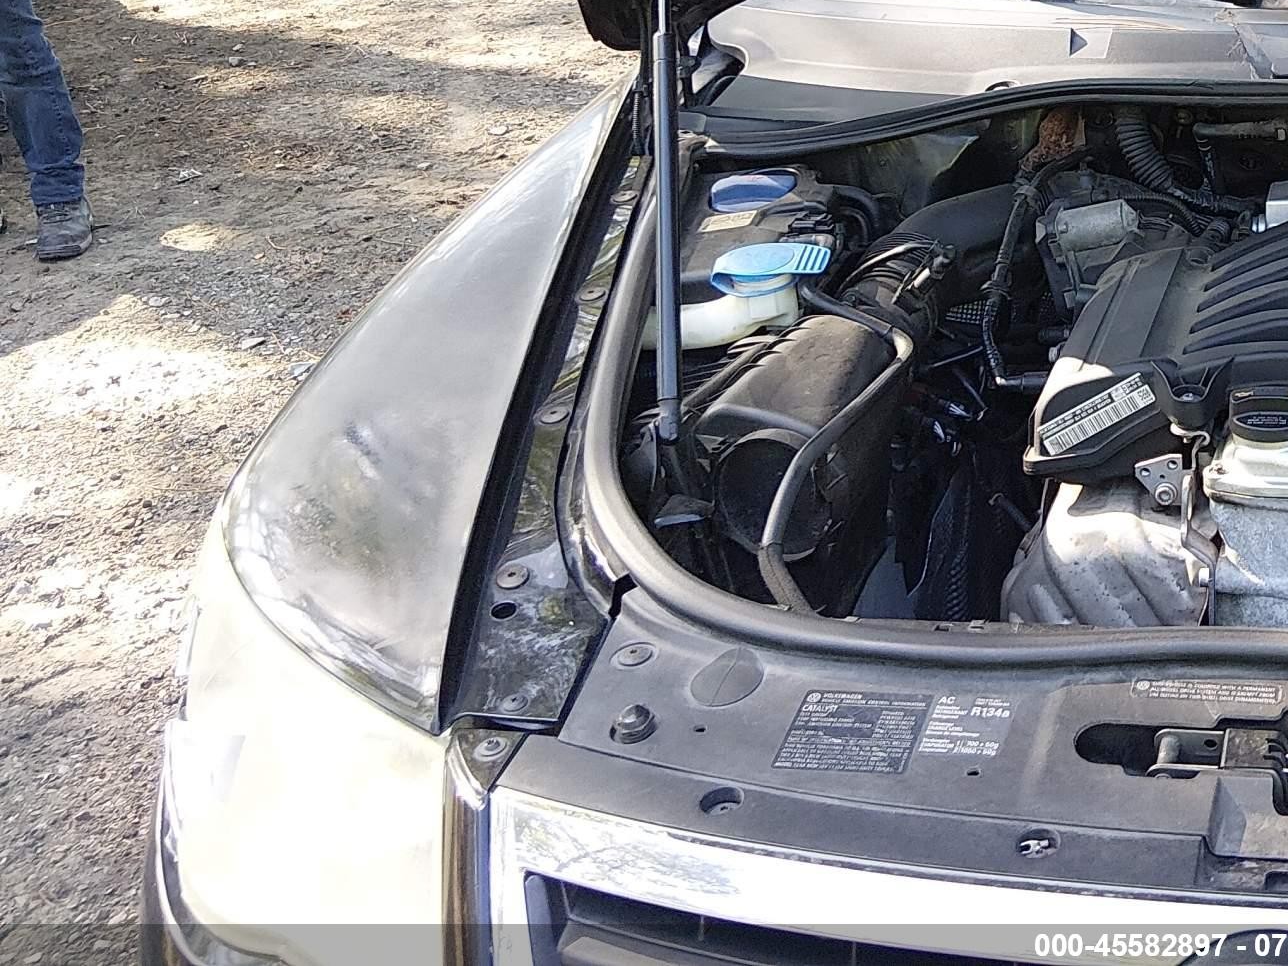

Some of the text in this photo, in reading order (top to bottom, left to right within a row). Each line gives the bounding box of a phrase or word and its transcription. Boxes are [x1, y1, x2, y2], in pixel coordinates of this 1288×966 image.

[938, 696, 956, 704] AC
[802, 704, 839, 713] CATALYST
[970, 707, 1010, 718] R134a
